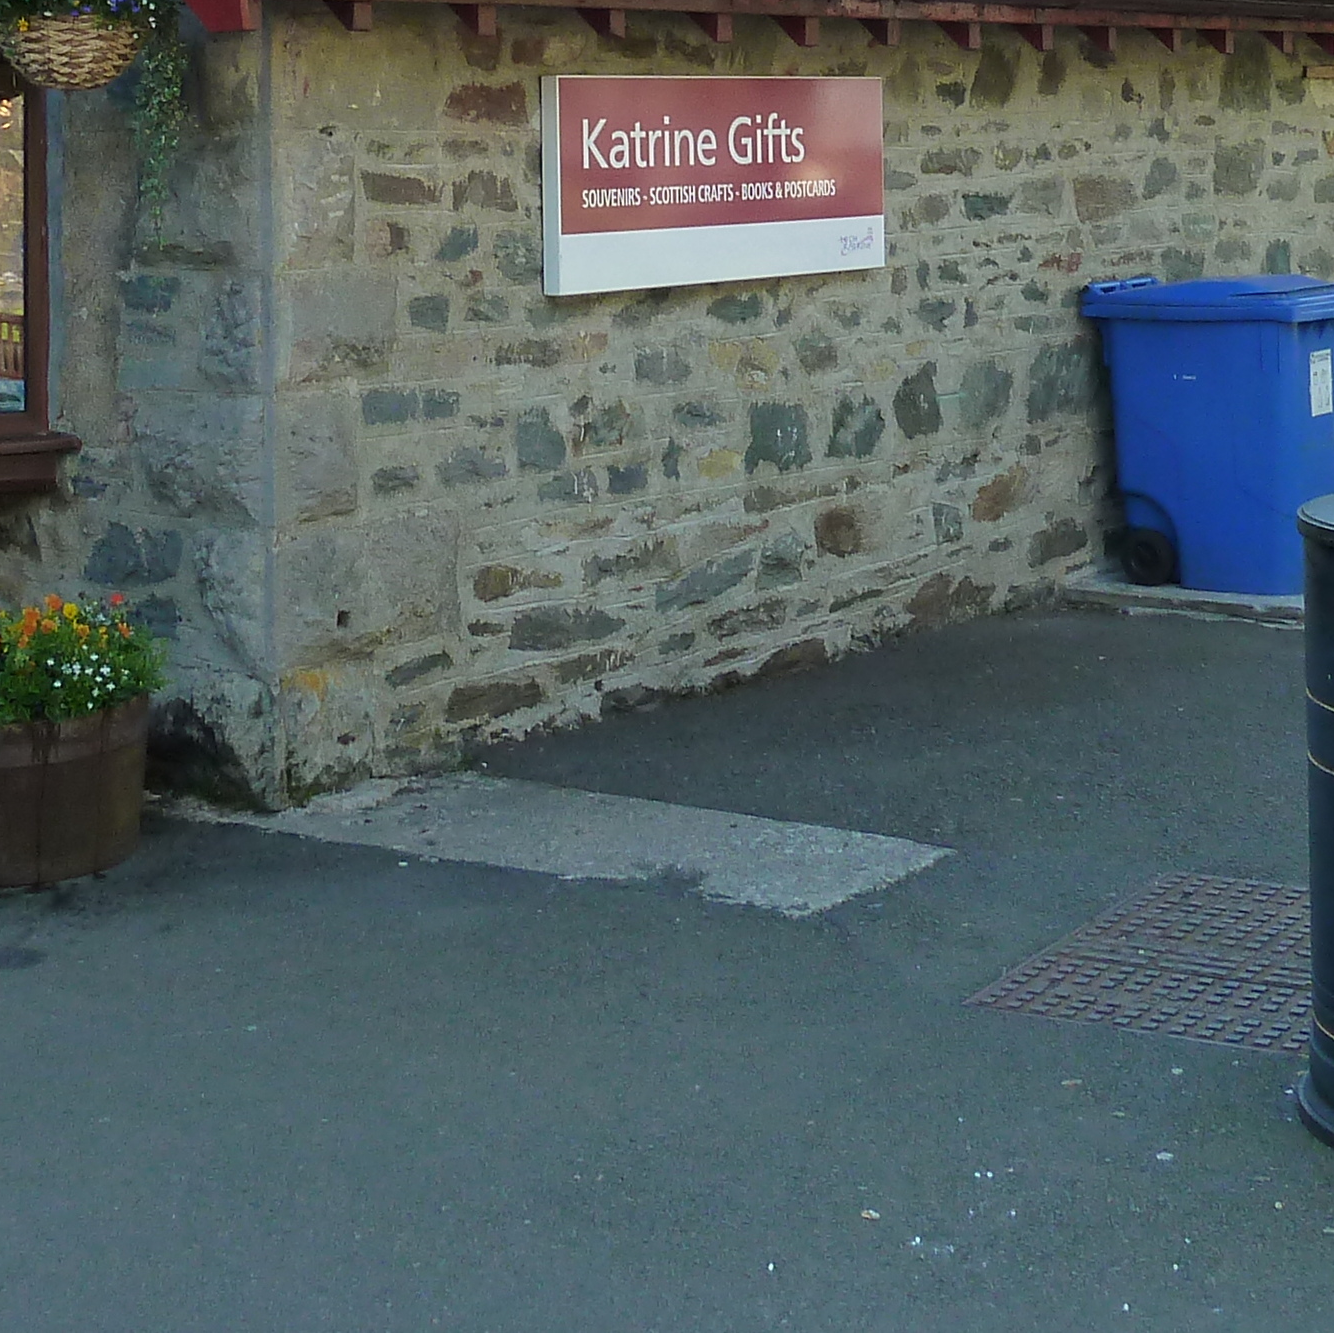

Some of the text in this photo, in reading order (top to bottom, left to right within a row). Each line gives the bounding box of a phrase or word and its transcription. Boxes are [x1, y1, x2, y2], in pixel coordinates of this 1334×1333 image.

[582, 112, 805, 170] Katrine Gifts
[581, 186, 641, 208] SOUVENIRS
[649, 184, 697, 206] SCOTTISH
[698, 183, 734, 204] CRAFTS
[741, 182, 773, 201] BOOKS
[775, 182, 783, 199] &
[784, 179, 836, 199] POSTCARDS
